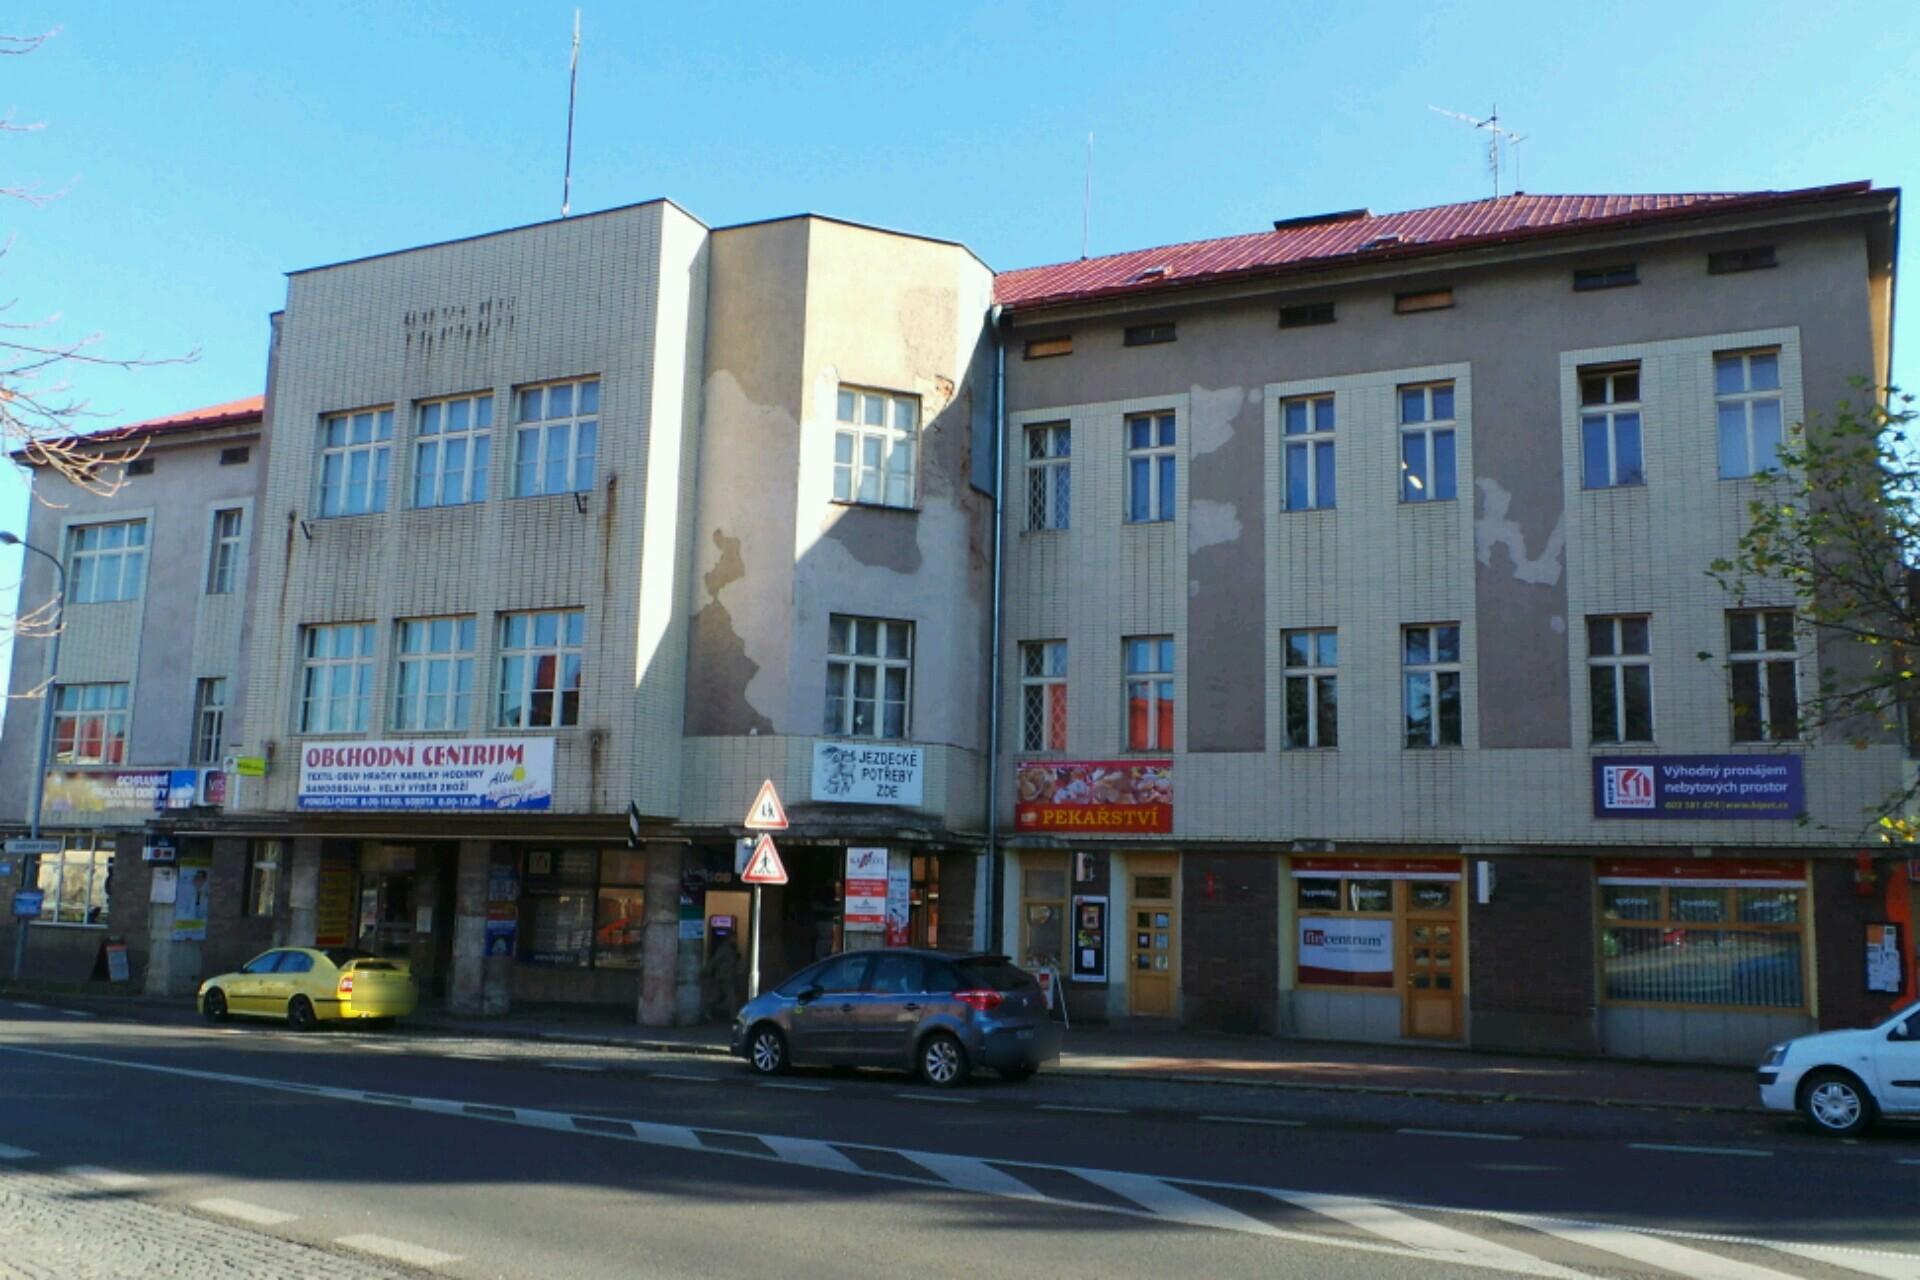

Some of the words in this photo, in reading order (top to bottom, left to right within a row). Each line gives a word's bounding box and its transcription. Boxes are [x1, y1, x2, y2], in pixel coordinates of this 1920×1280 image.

[306, 743, 415, 768] OBCHODNÍ
[859, 750, 917, 767] JEZDECKÉ
[862, 764, 913, 782] POTŘEBY
[1663, 764, 1720, 779] Výhodný
[1723, 765, 1787, 779] pronájem
[877, 784, 898, 798] ZDE
[1665, 781, 1737, 795] nebytových
[1740, 783, 1789, 795] prostor
[1043, 807, 1158, 825] PEKAŘSTVÍ
